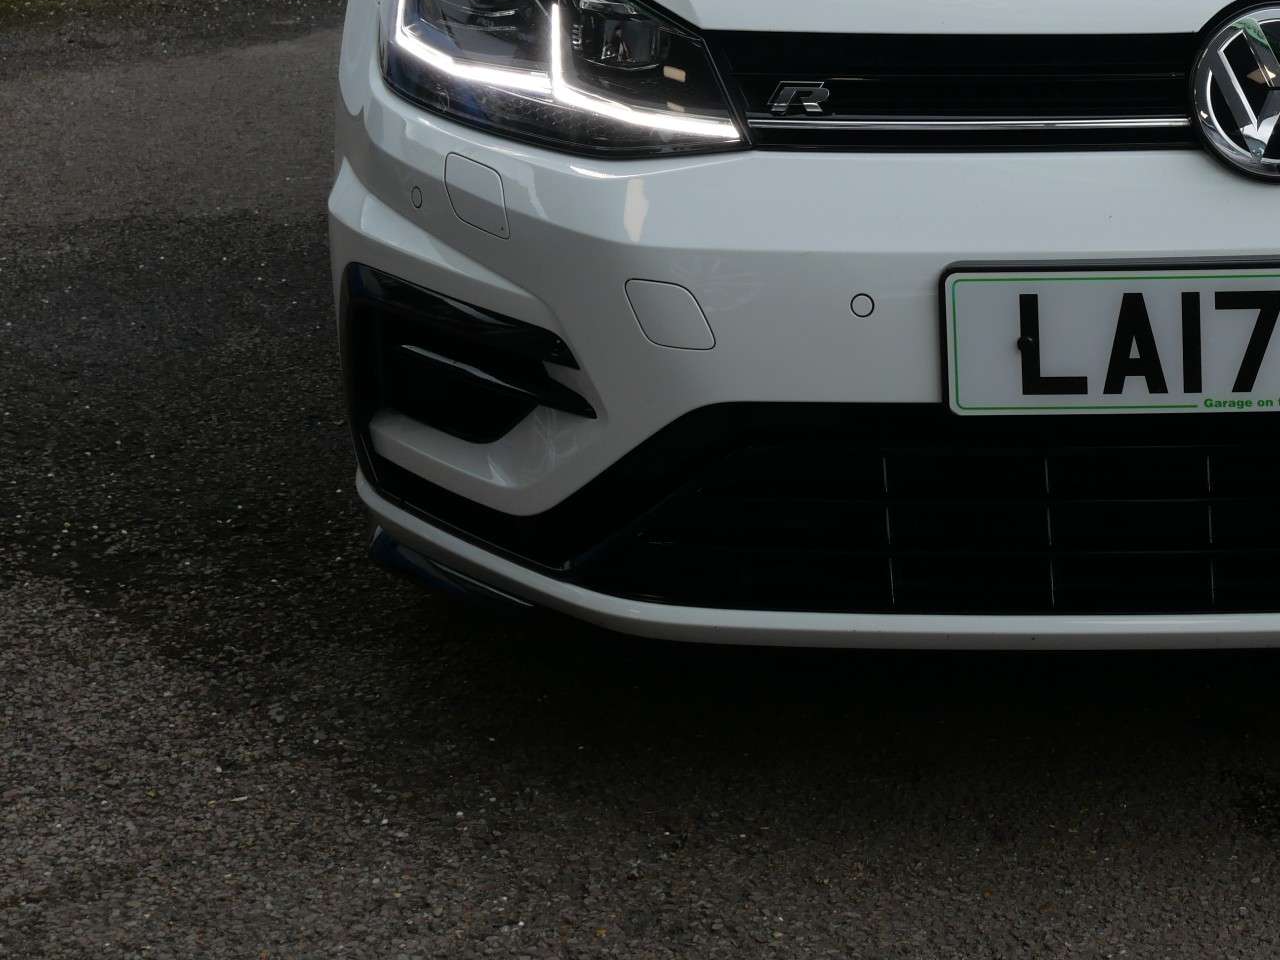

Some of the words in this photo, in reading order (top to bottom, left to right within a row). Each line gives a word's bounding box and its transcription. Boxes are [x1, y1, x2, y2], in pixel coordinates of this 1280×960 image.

[767, 80, 830, 113] R
[1203, 398, 1253, 409] Garage
[1257, 399, 1274, 408] on
